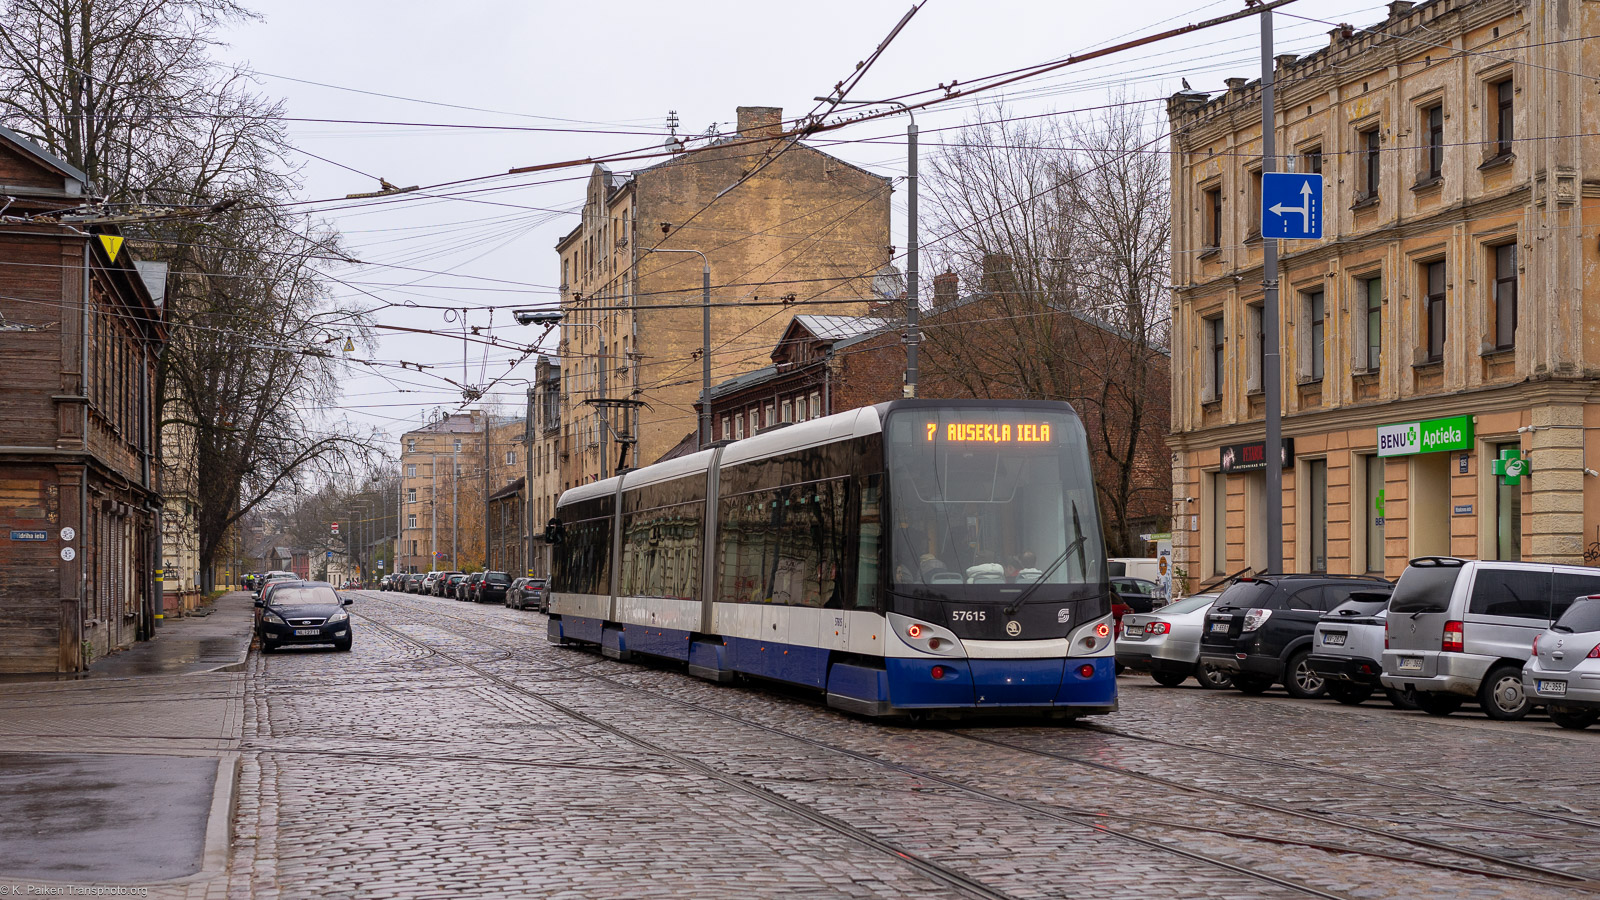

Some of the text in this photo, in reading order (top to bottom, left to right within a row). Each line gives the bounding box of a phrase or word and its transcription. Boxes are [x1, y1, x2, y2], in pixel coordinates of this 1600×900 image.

[927, 424, 1050, 443] 7 AUSEKĻA IELA
[1381, 426, 1462, 449] BENU Aptieka
[952, 611, 986, 621] 57615
